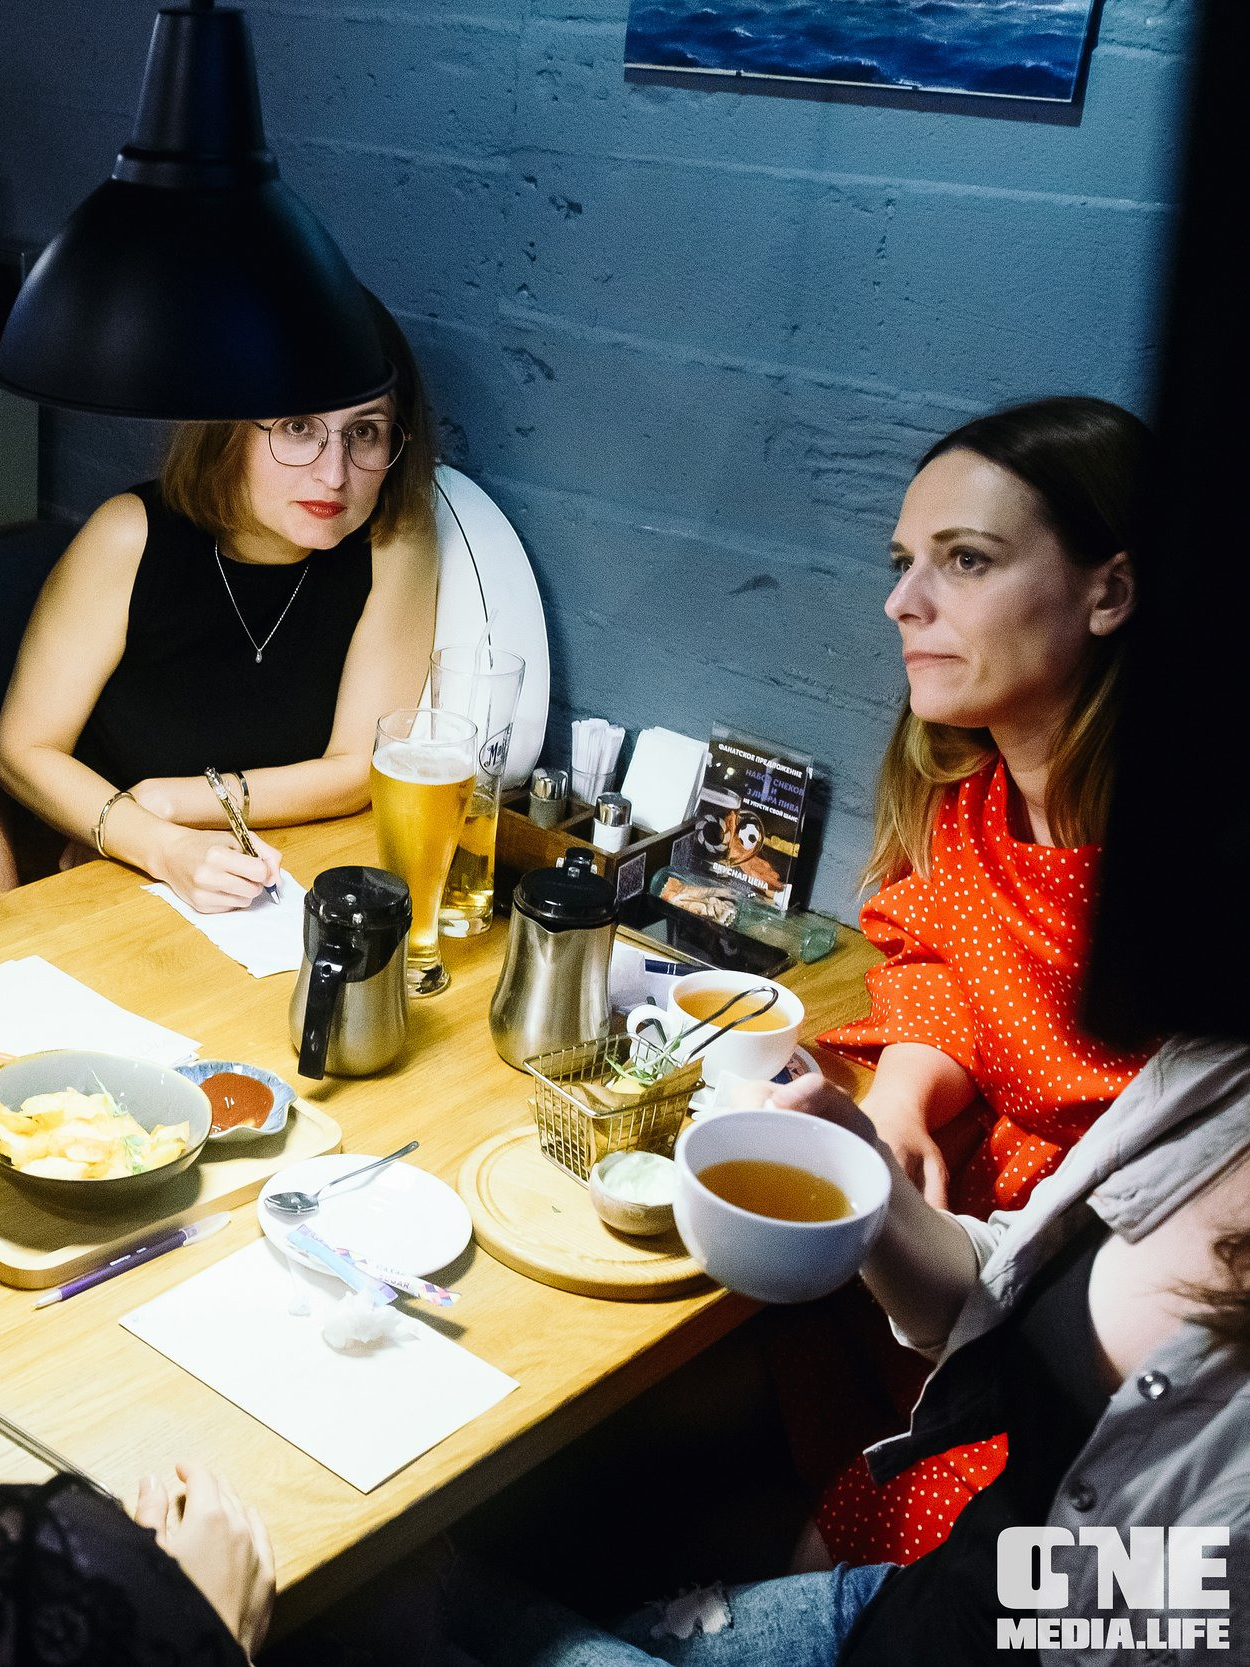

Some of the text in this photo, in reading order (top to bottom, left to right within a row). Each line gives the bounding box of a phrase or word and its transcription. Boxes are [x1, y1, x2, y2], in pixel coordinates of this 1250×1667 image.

[718, 743, 803, 779] ФАНАТСКОЕ ПРЕДЛОЖЕНИЕ
[778, 799, 799, 813] ПИВА
[712, 861, 748, 882] ВКУСНАЯ
[747, 875, 769, 891] ЦЕНА
